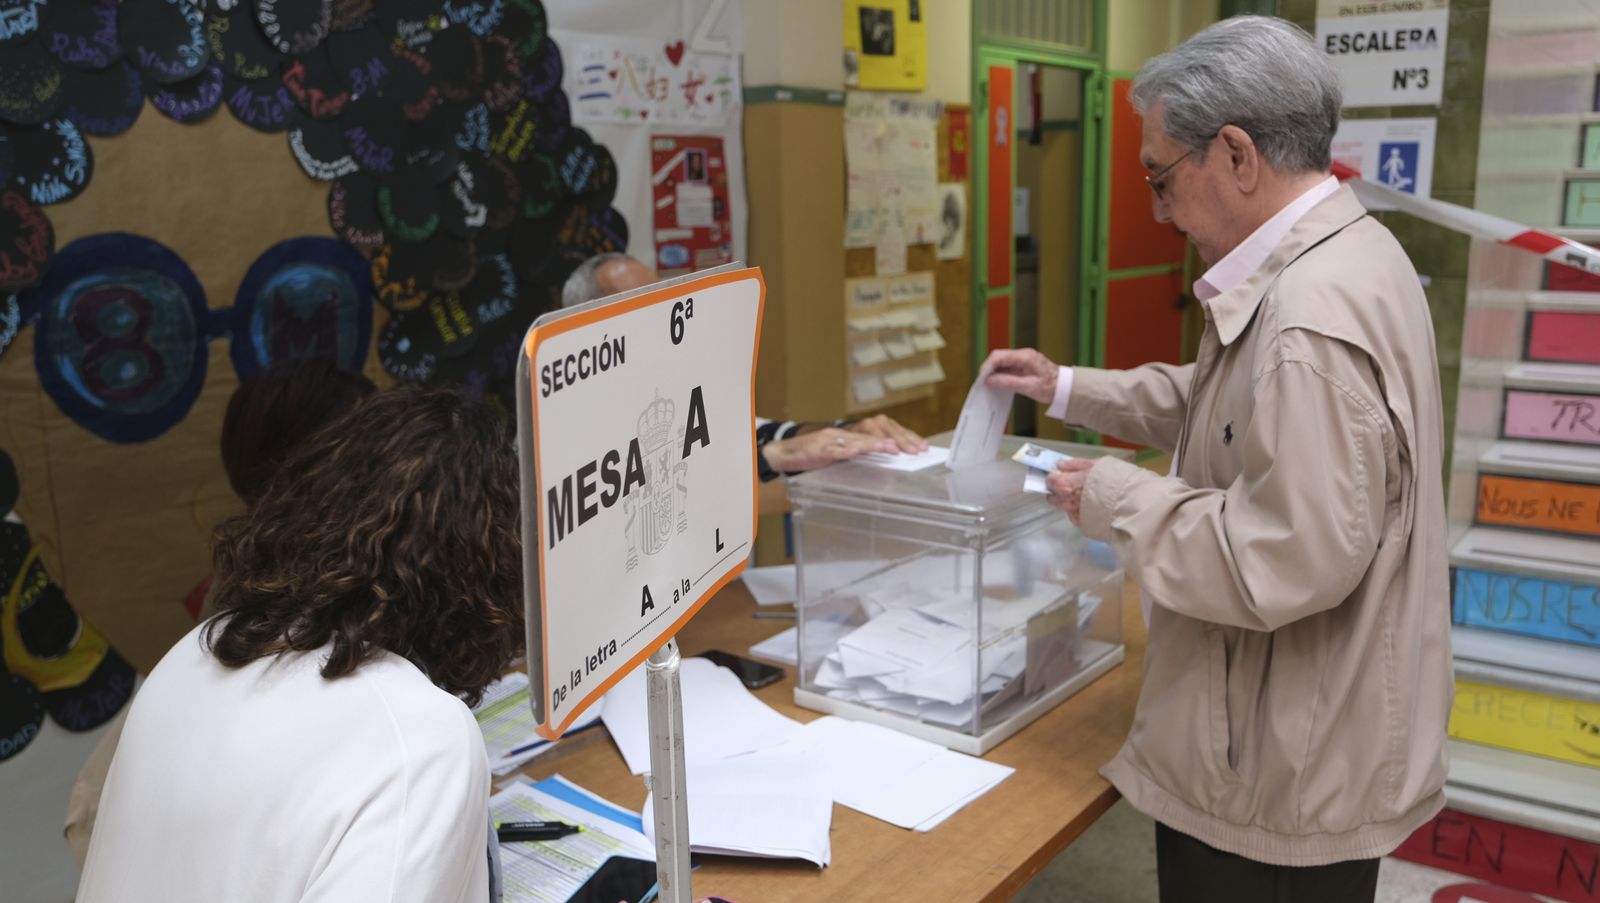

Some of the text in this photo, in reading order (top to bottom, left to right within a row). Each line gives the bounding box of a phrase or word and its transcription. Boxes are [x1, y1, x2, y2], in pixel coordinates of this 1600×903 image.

[1326, 28, 1438, 54] ESCALERA
[541, 334, 626, 399] SECCIÓN
[1551, 398, 1600, 435] TR
[547, 385, 711, 551] MESA A
[553, 527, 725, 712] De la letra A a la L
[1432, 816, 1505, 875] EN
